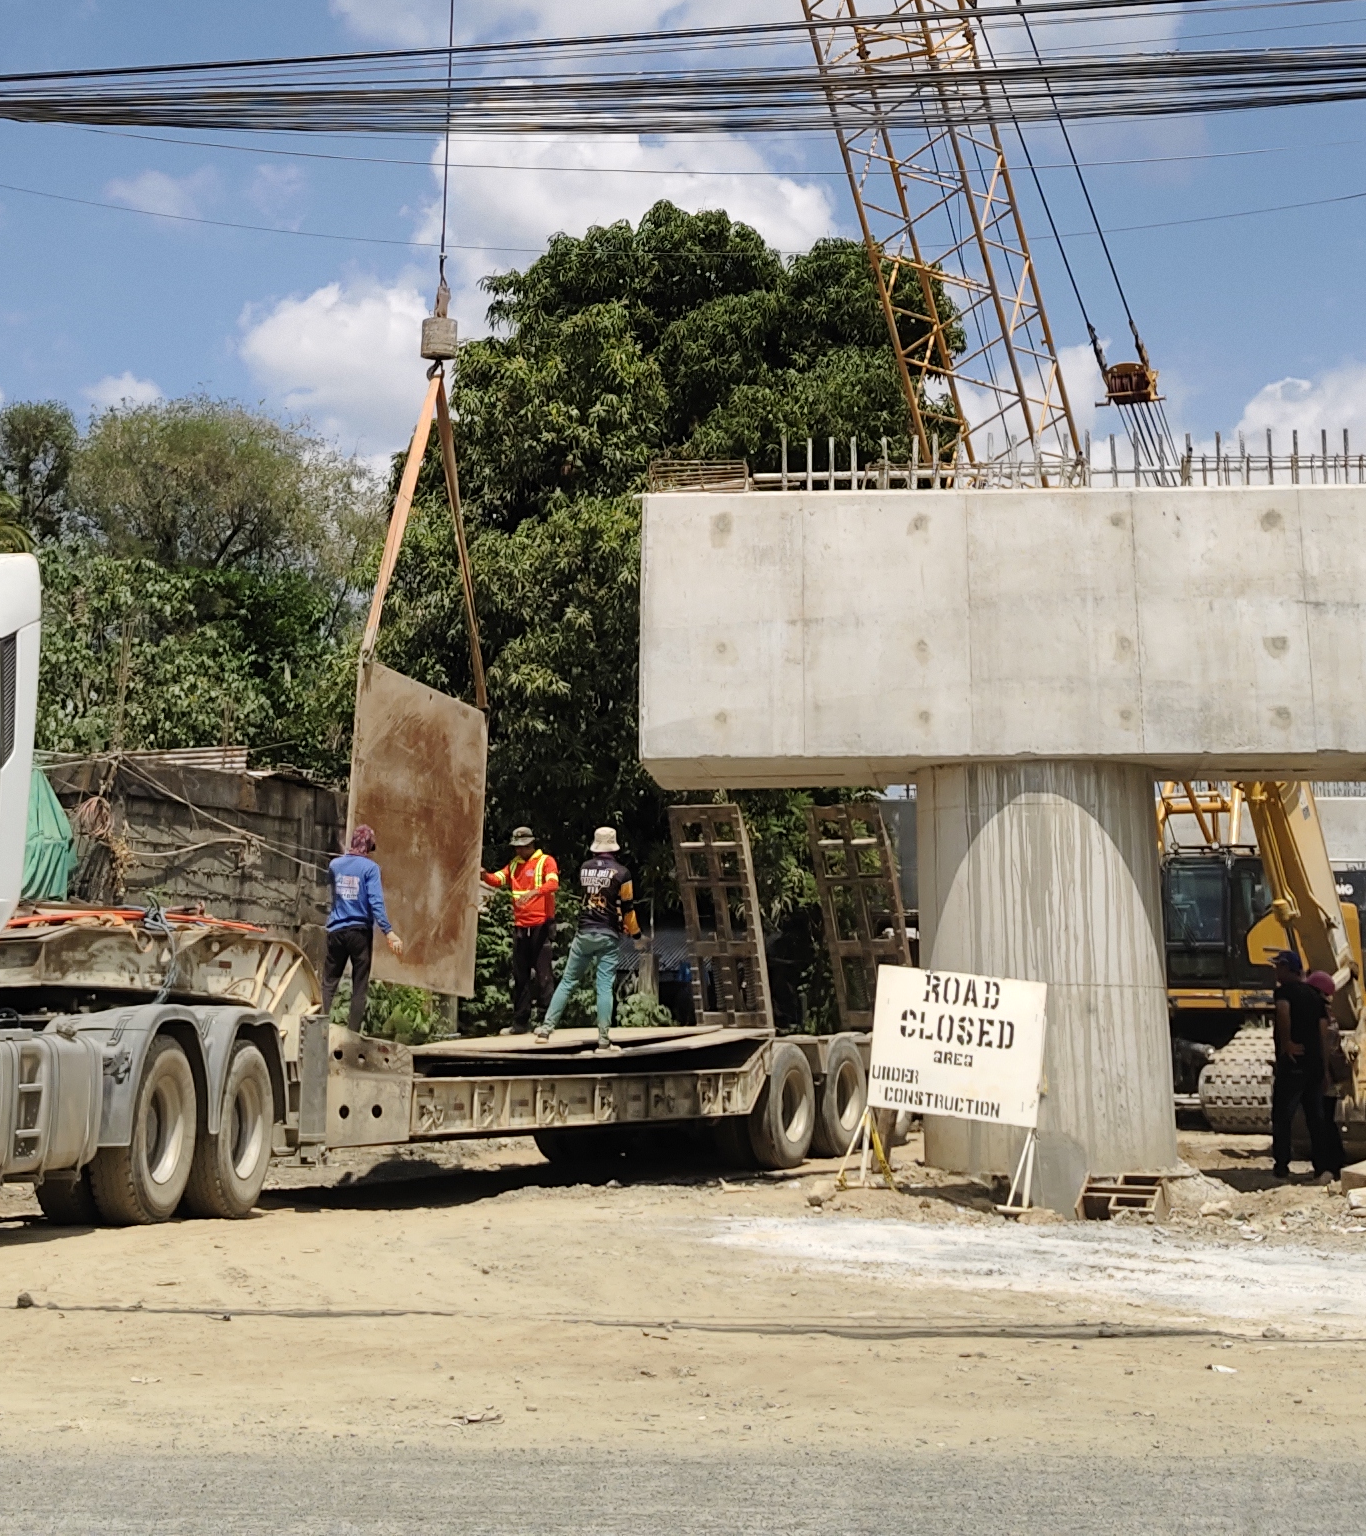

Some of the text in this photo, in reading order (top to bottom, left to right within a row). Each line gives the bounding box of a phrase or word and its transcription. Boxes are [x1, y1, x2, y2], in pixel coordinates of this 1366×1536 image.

[922, 973, 1001, 1010] ROAD
[900, 1009, 1015, 1049] CLOSED
[871, 1064, 919, 1084] UNDER
[884, 1086, 1001, 1118] CONSTRUCTION
